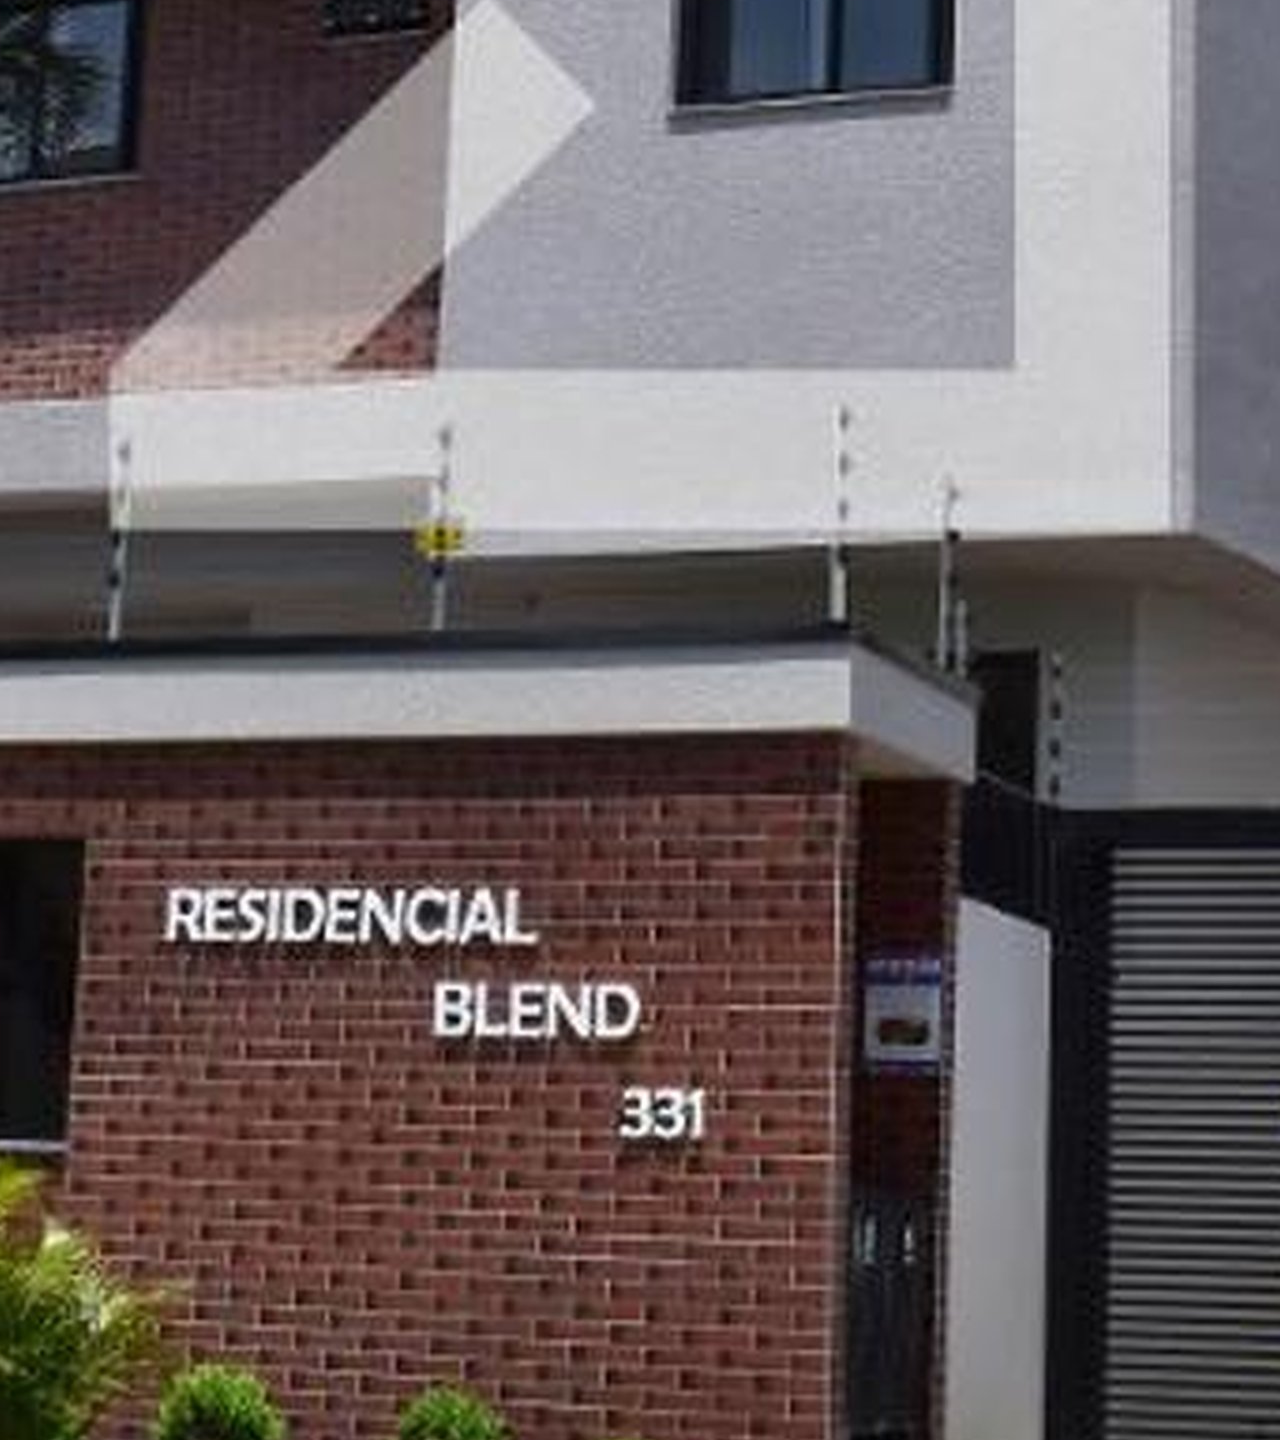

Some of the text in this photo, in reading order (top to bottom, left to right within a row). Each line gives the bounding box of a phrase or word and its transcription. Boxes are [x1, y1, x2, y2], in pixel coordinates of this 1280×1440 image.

[163, 887, 538, 945] RESIDENCIAL
[431, 981, 642, 1039] BLEND
[619, 1087, 706, 1139] 331
